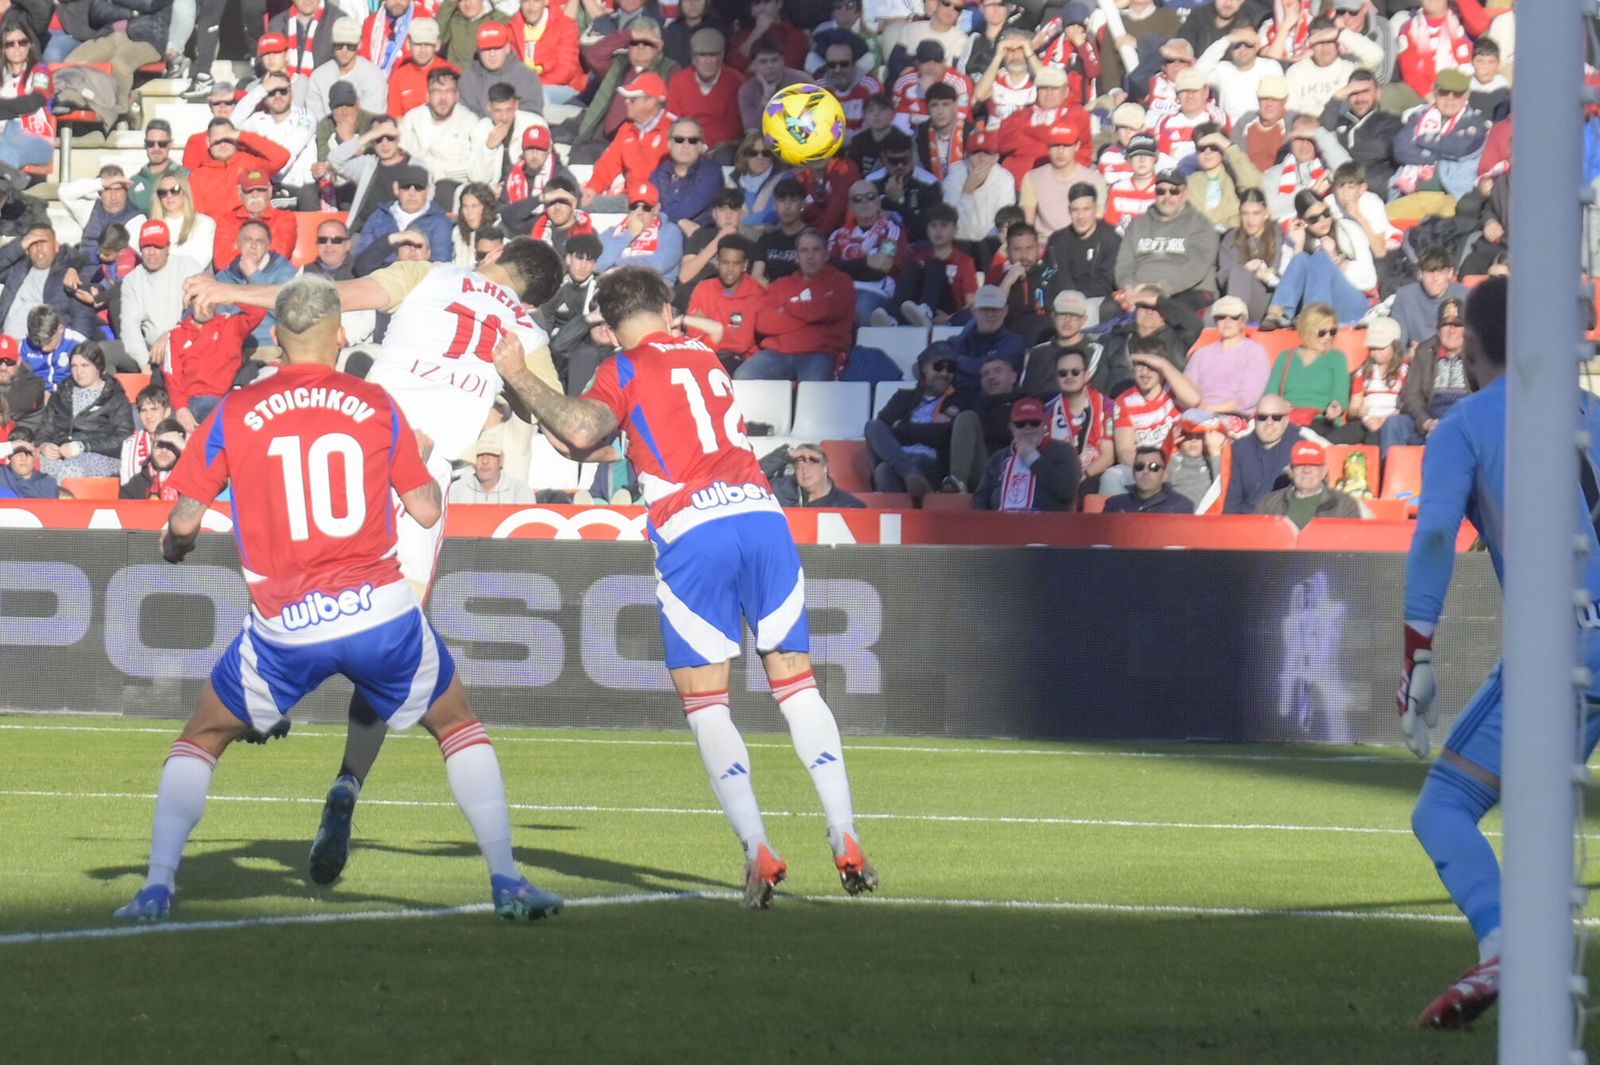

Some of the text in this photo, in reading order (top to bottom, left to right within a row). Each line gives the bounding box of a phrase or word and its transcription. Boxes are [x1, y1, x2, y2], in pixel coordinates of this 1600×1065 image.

[243, 387, 376, 431] STOICHKOV
[671, 368, 754, 454] 12
[267, 432, 366, 541] 10
[281, 583, 373, 631] wiber
